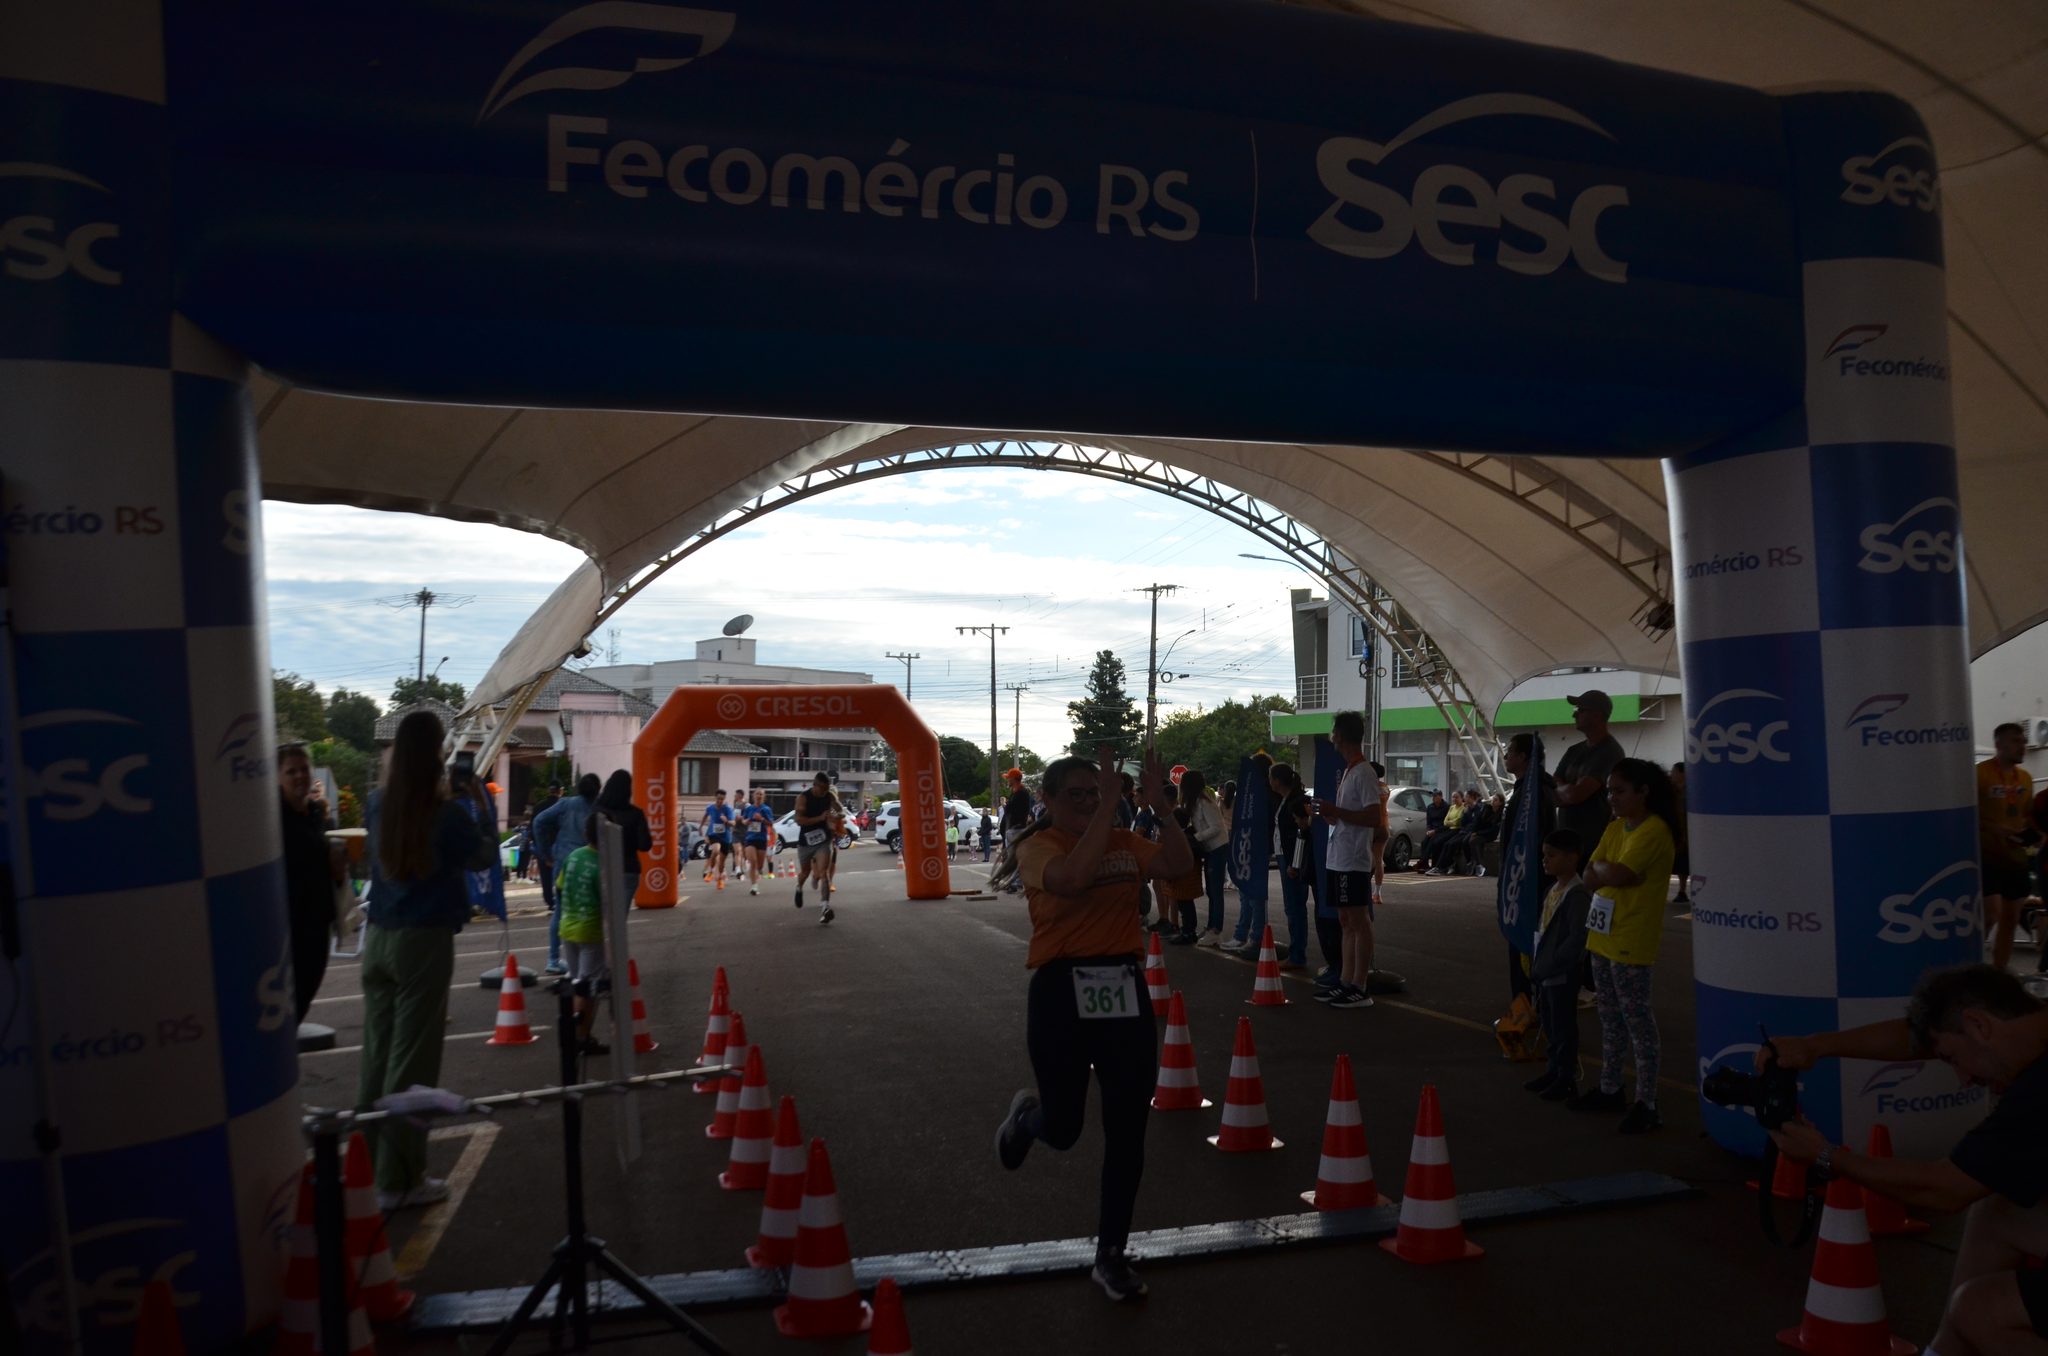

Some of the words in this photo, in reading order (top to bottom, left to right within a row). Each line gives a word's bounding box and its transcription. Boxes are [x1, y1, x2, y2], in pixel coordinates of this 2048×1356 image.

[546, 112, 1068, 230] Fecomércio
[1095, 162, 1201, 242] RS
[1840, 155, 1939, 213] Ses
[1306, 134, 1631, 284] Sesc
[0, 214, 122, 286] sc
[115, 505, 165, 535] RS
[1767, 545, 1803, 568] RS
[755, 695, 862, 718] CRESOL
[647, 770, 666, 861] CRESOL
[917, 762, 938, 850] CRESOL
[1586, 908, 1606, 930] 93
[1786, 911, 1823, 932] RS
[1083, 985, 1126, 1013] 361
[156, 1014, 205, 1048] RS
